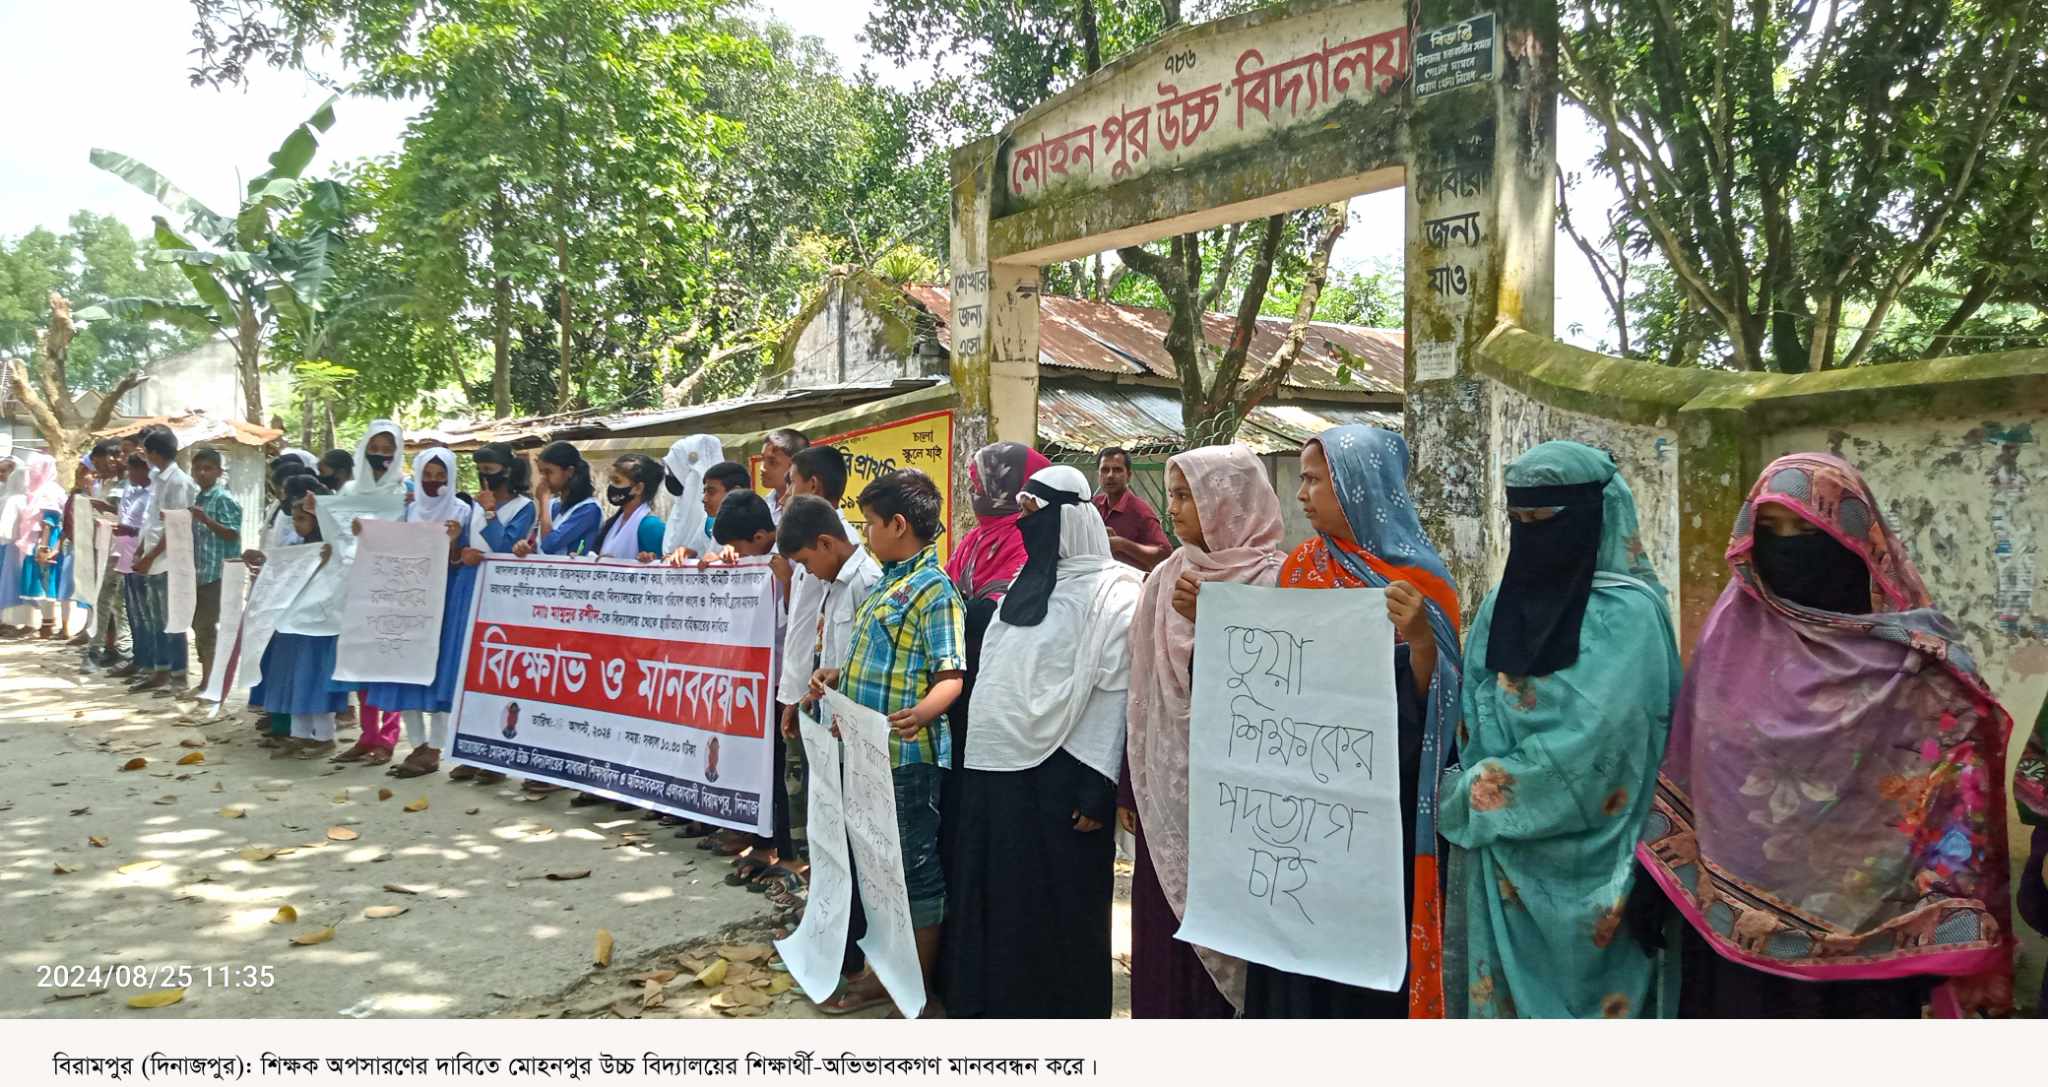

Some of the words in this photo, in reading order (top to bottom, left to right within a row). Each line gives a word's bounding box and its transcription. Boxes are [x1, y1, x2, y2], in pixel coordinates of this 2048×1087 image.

[1165, 48, 1197, 74] ৭৮৬
[1157, 82, 1221, 150] উচ্চ
[1232, 27, 1409, 129] বিদ্যালয়
[1424, 211, 1480, 249] জন্য
[1426, 262, 1468, 298] যাও
[958, 304, 982, 329] জন্য
[902, 447, 924, 464] স্কুলে
[926, 444, 943, 463] যাই
[912, 428, 935, 443] চলো
[479, 625, 592, 696] বিক্ষোভ
[601, 658, 626, 701] ও
[637, 657, 766, 731] মানববন্ধন
[1229, 695, 1374, 783] শিক্ষকের
[1248, 826, 1318, 925] চাই
